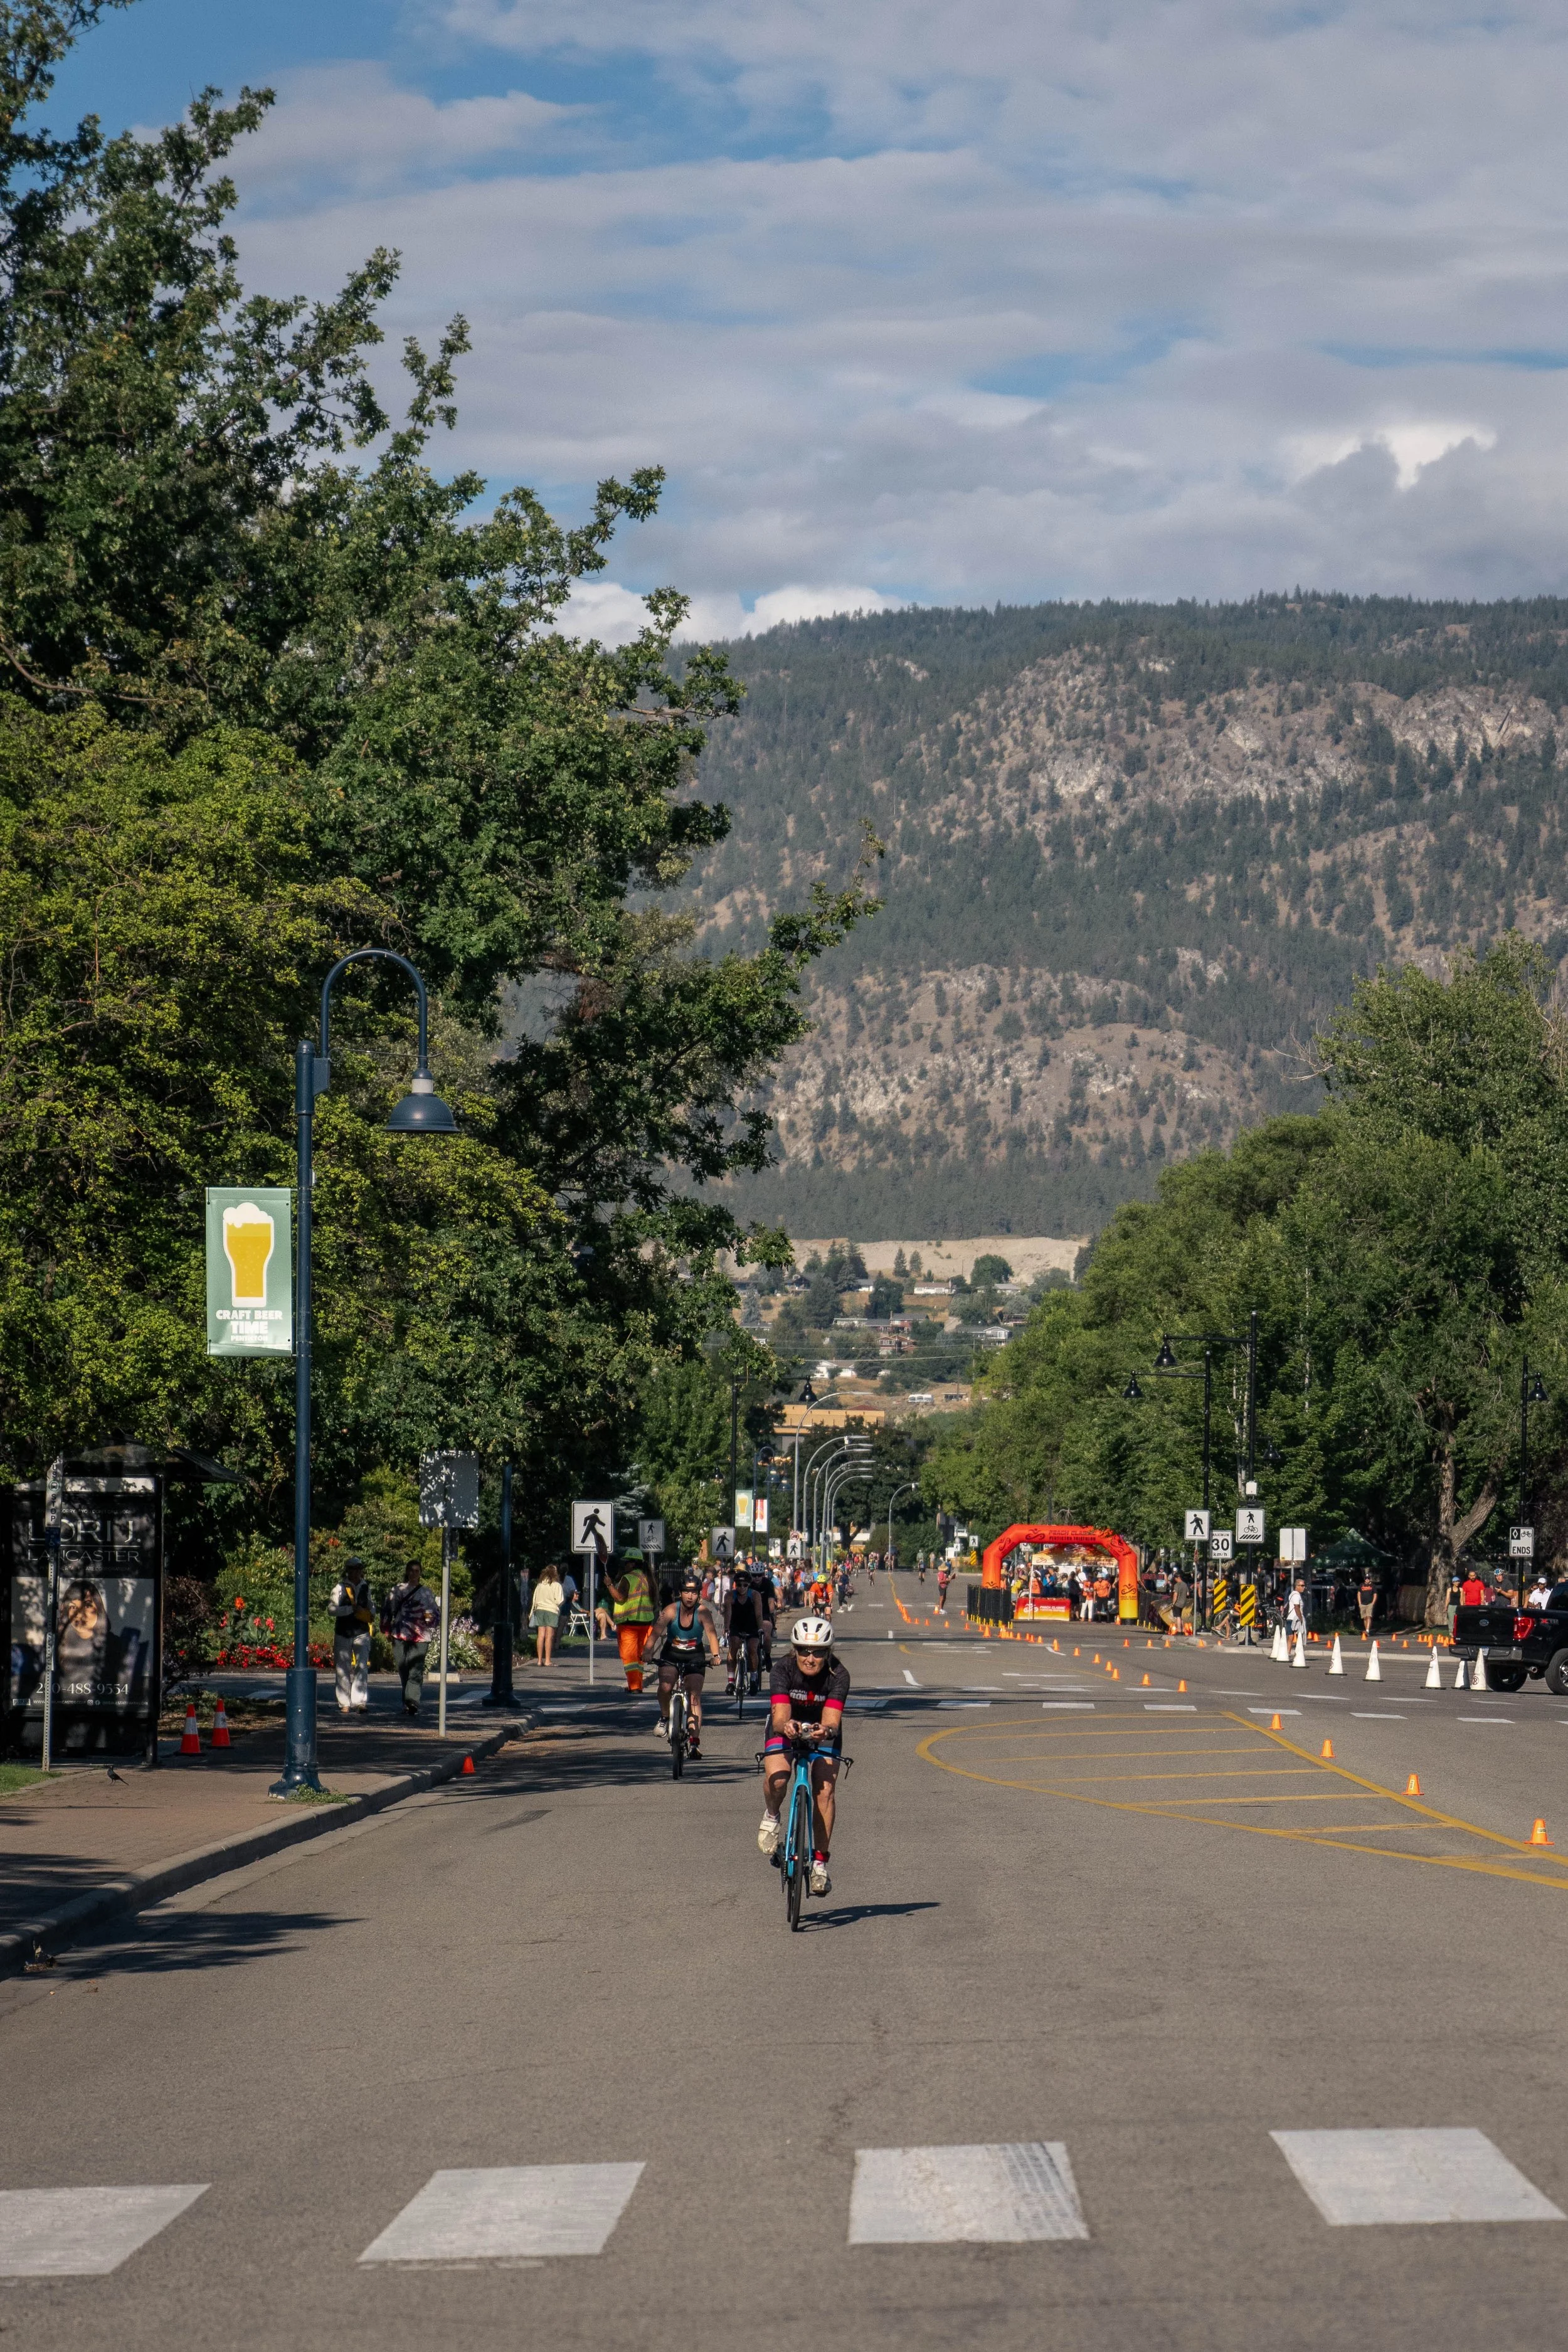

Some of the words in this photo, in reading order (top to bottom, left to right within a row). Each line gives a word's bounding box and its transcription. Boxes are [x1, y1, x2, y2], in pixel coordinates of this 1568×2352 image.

[216, 1310, 251, 1320] CRAFT
[254, 1310, 283, 1320] BEER
[230, 1321, 268, 1334] TIME
[124, 1520, 141, 1543] J.
[1211, 1538, 1229, 1550] 30
[1512, 1546, 1531, 1554] ENDS
[36, 1682, 129, 1695] 20-488-9554
